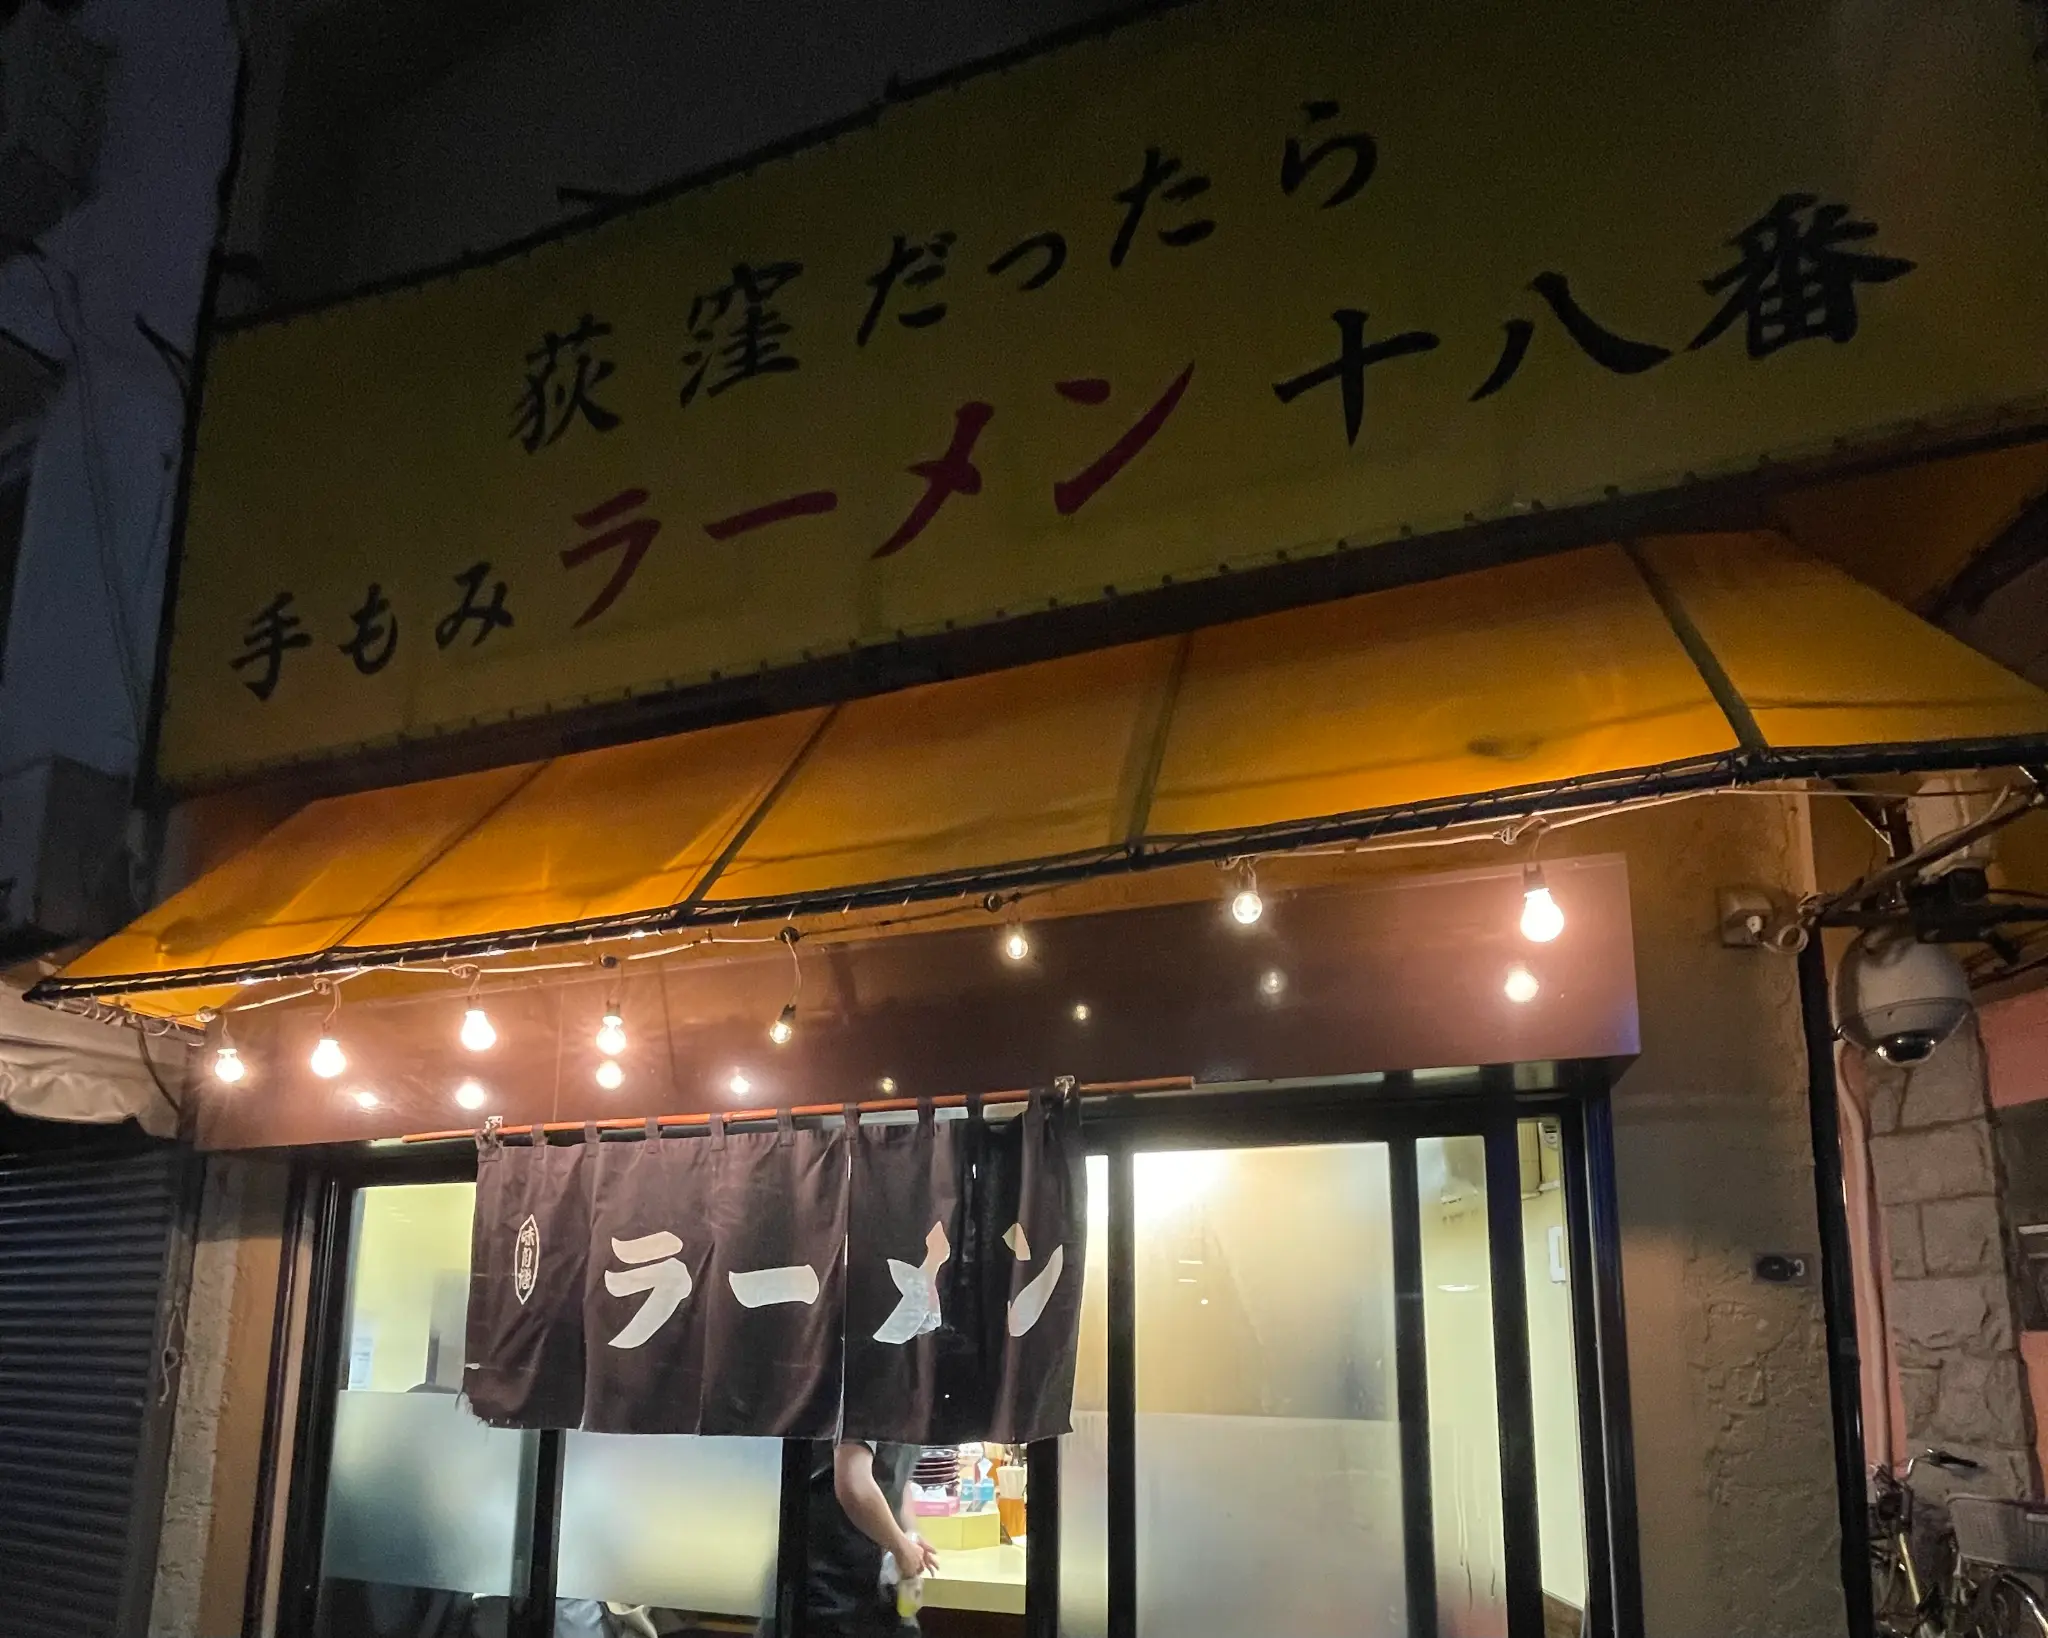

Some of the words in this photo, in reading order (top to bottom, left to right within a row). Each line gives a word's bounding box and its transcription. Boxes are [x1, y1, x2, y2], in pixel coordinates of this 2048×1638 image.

[508, 101, 1377, 455] 荻窪だったら
[605, 1221, 1063, 1349] ラーメン
